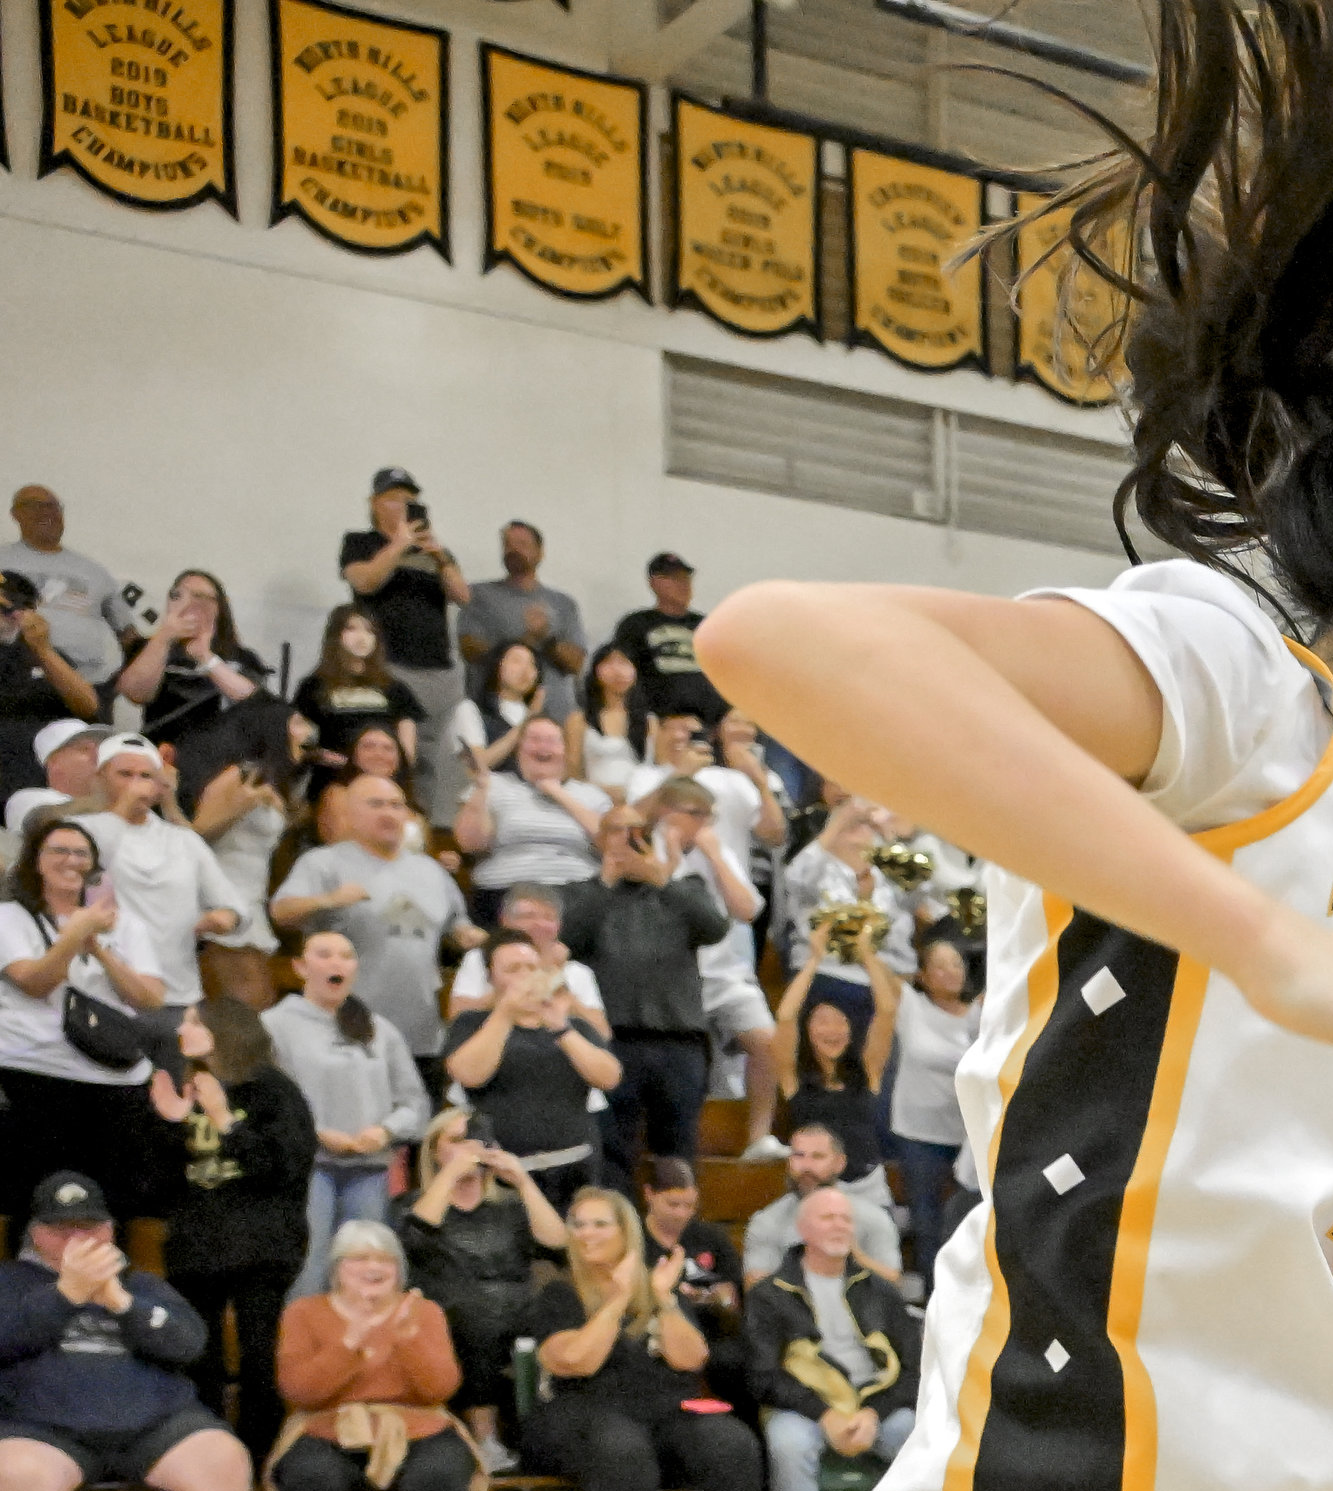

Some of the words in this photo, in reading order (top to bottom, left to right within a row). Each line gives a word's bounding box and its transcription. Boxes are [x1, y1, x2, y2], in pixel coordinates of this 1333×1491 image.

[86, 23, 190, 68] LEAGUE
[62, 92, 216, 149] BASKETBALL
[314, 75, 410, 119] LEAGUE
[70, 126, 208, 181] CHAMPIONS
[293, 145, 431, 195] BASKETBALL
[299, 176, 425, 231] CHAMPIONS
